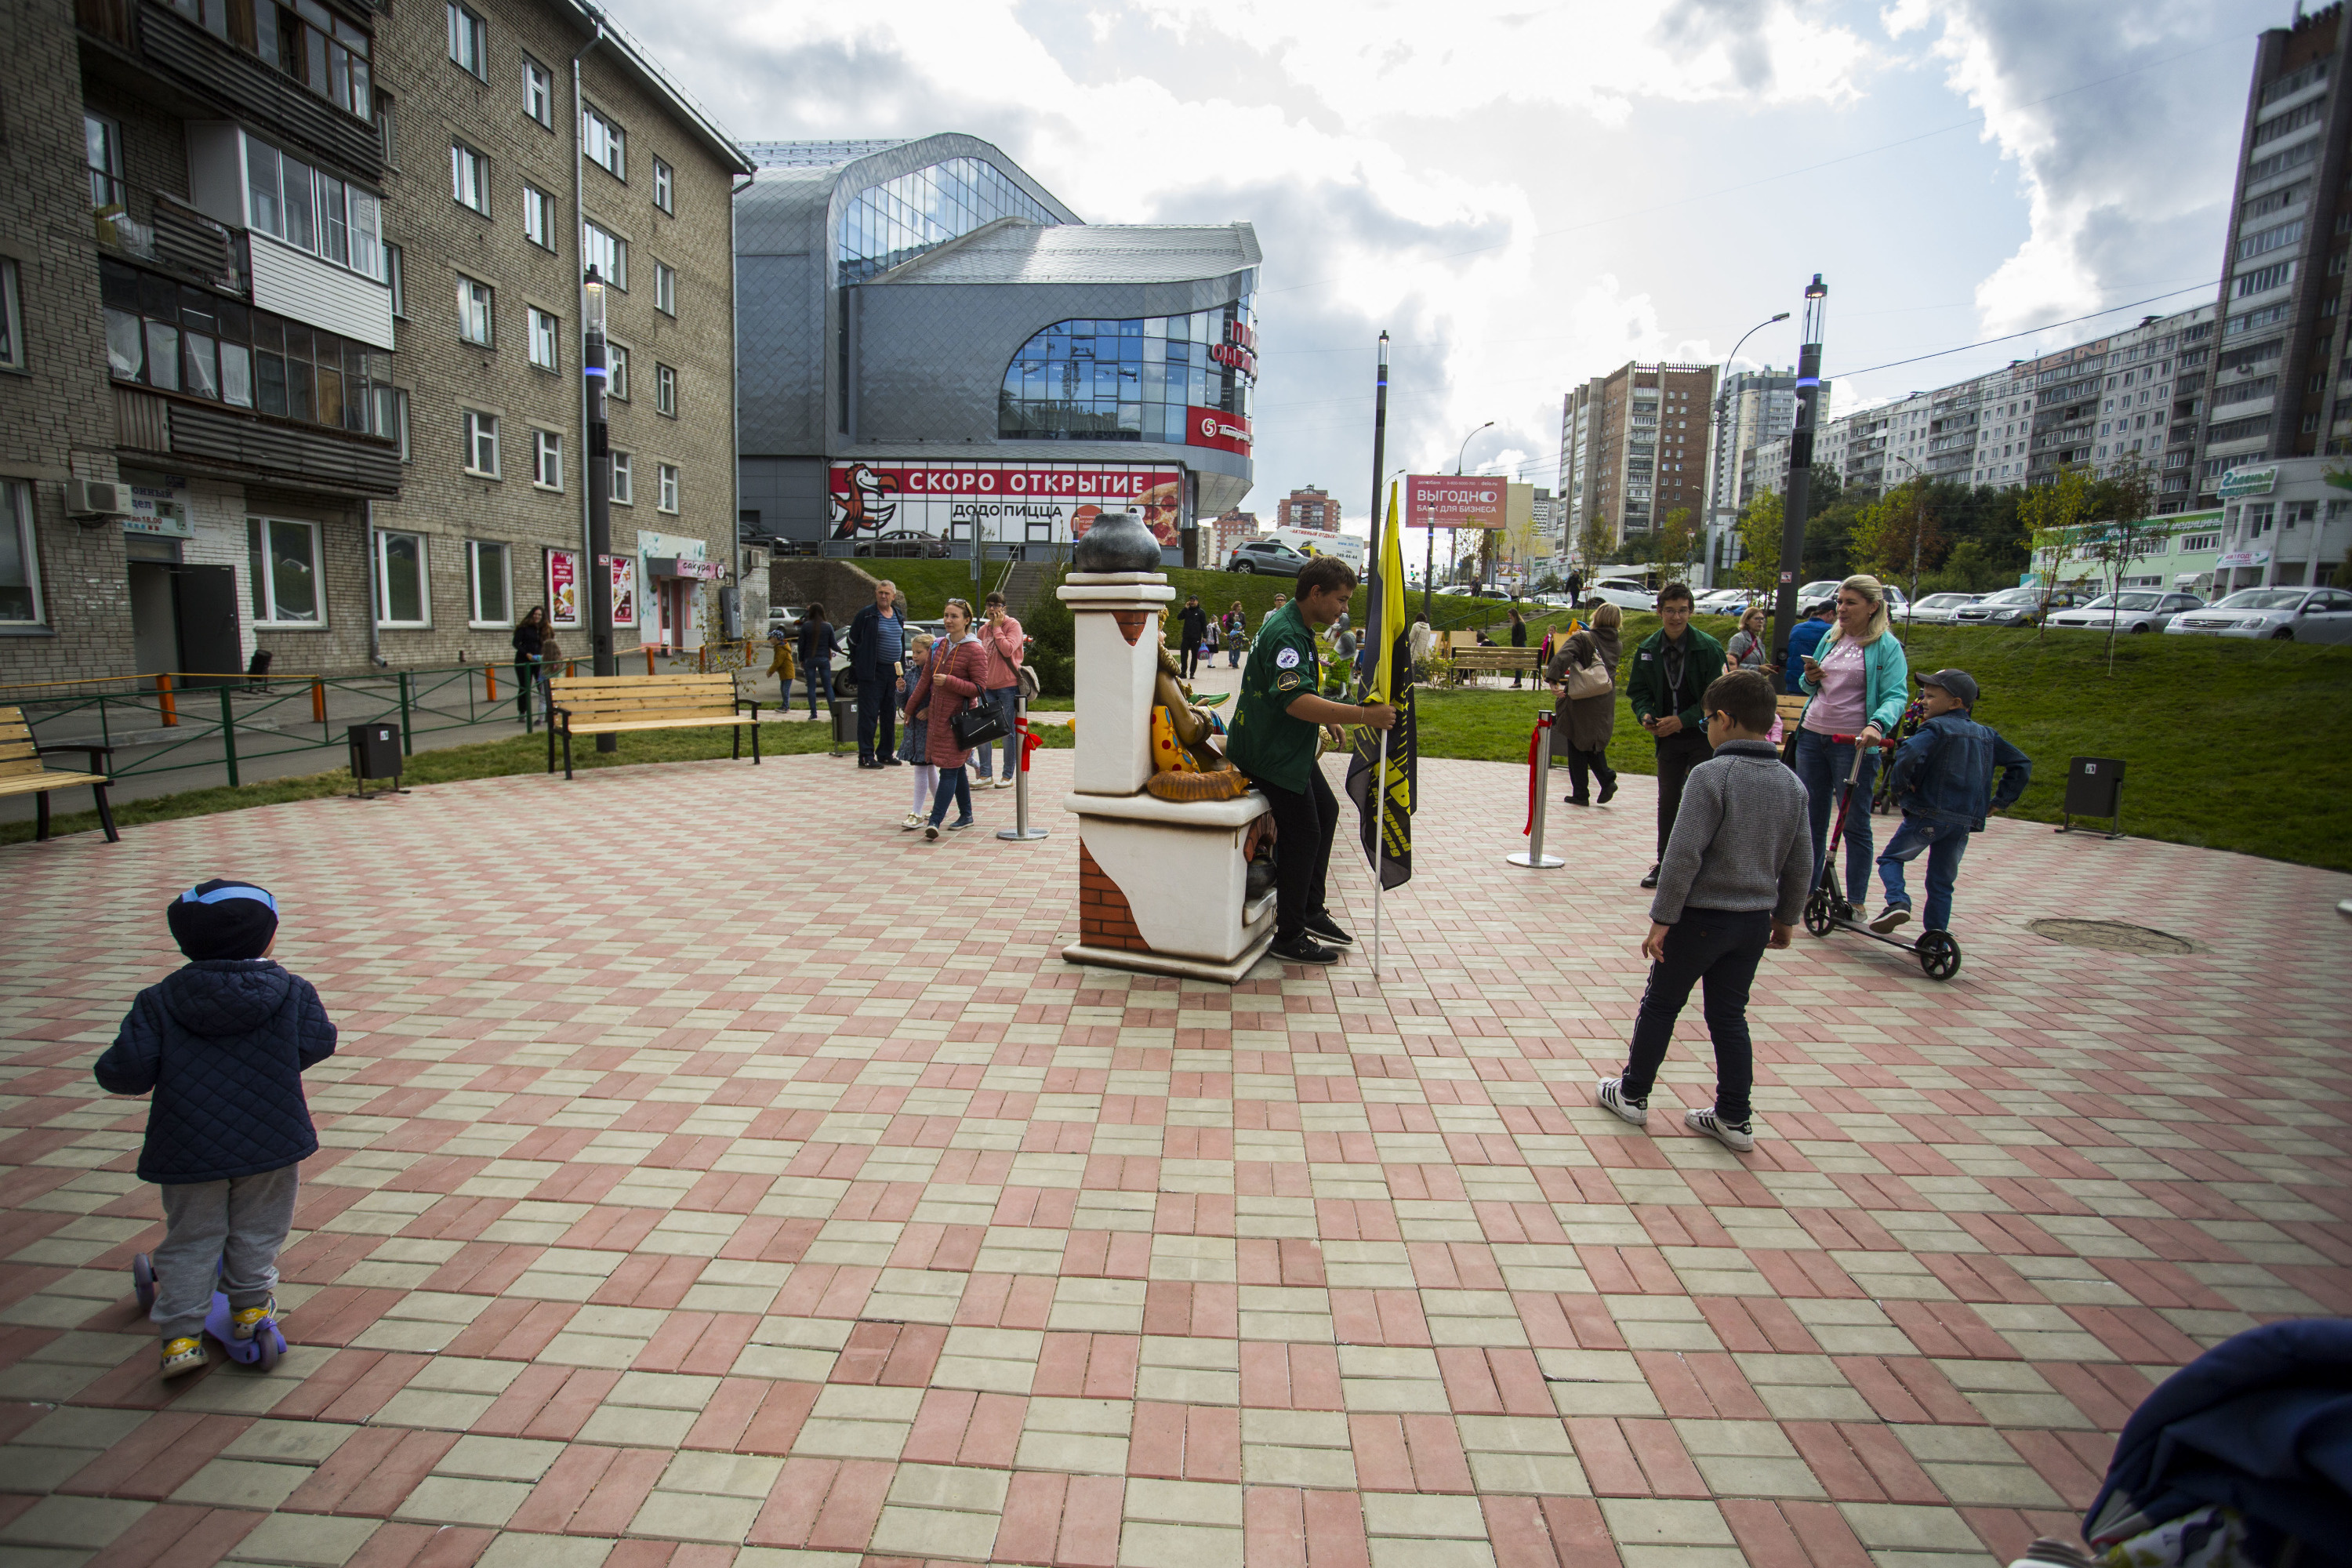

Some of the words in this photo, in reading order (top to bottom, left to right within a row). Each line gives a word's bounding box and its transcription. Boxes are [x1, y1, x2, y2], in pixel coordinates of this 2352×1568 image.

[909, 473, 995, 491] СКОРО
[1010, 474, 1144, 493] ОТКРЫТИЕ
[132, 487, 174, 499] онный
[953, 504, 1000, 517] ДОДО
[1004, 506, 1062, 519] ПИЦЦА
